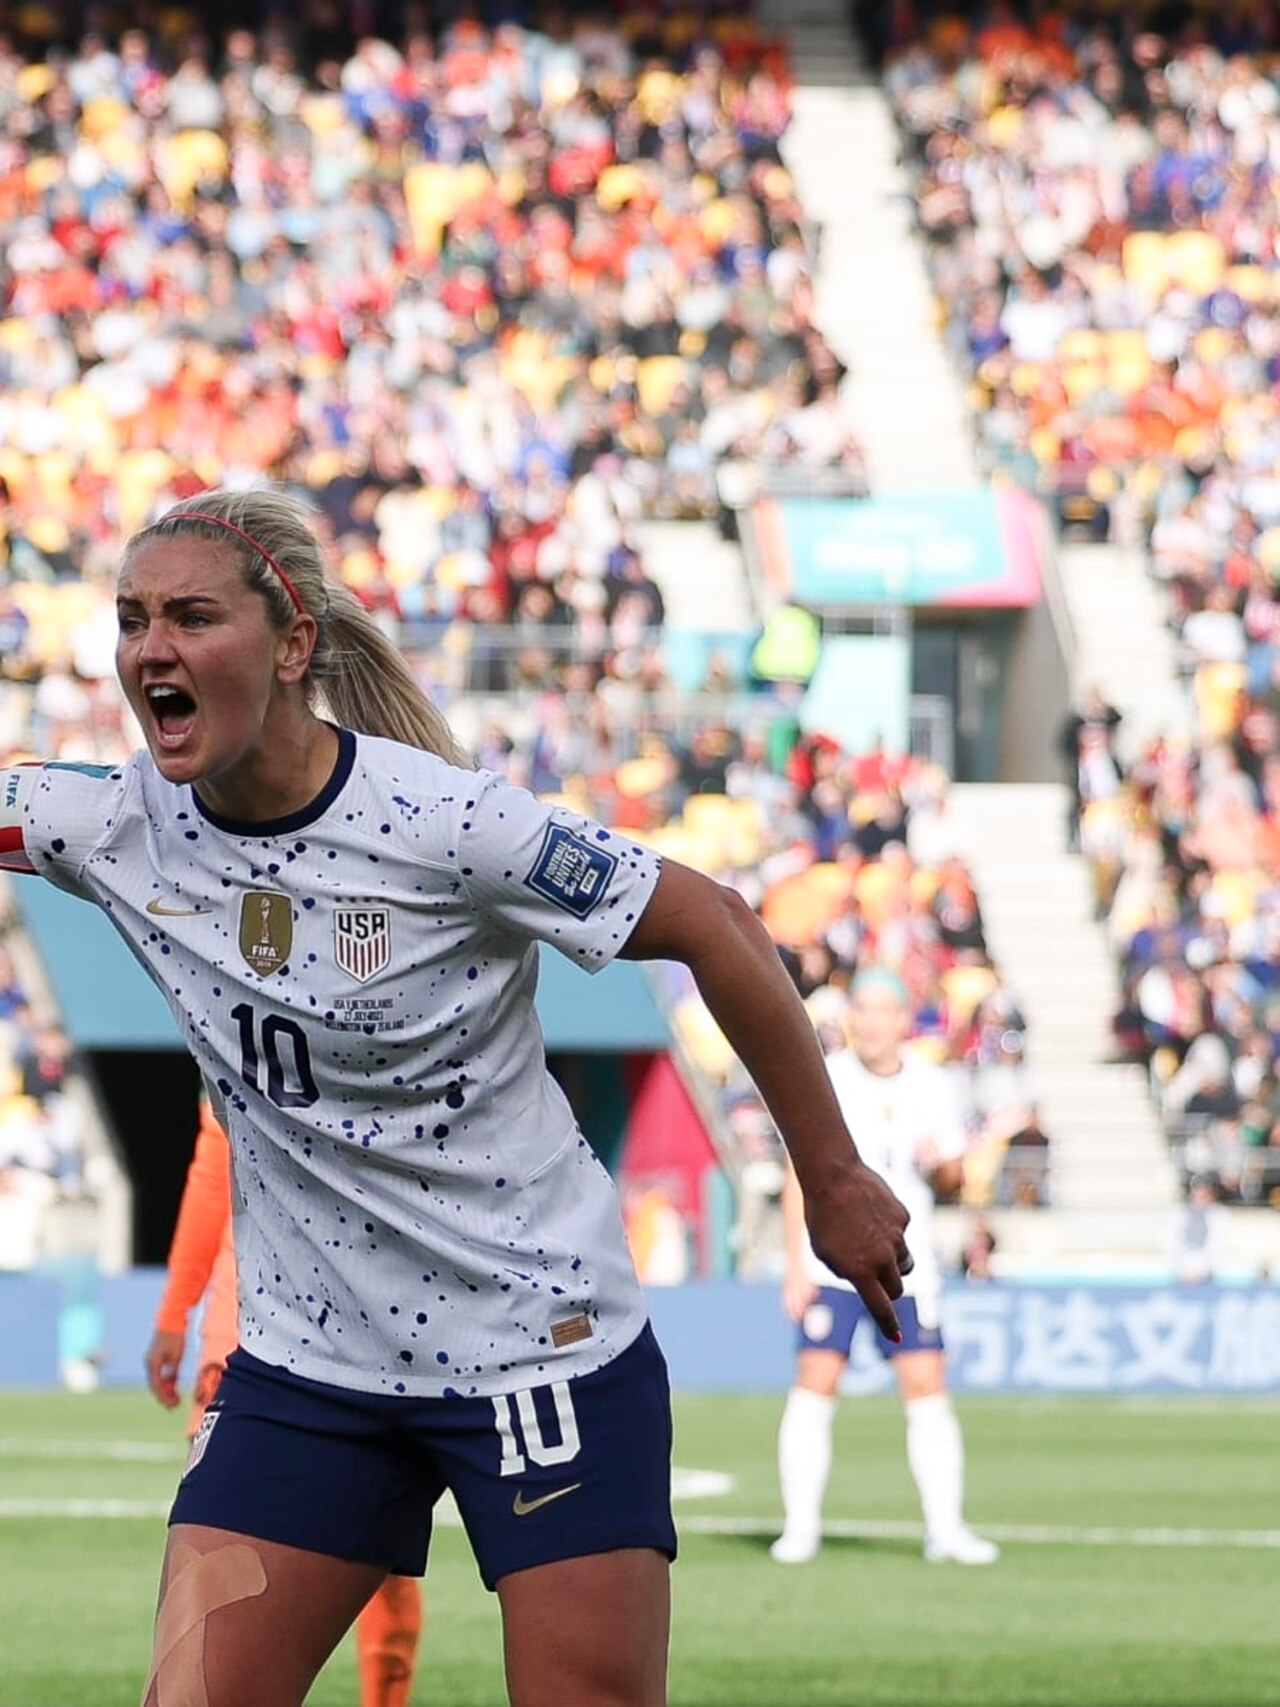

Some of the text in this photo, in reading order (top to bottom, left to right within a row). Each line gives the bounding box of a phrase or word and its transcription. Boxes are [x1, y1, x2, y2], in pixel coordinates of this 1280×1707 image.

[6, 774, 20, 807] FIFA
[543, 840, 568, 880] FOOTBALL
[551, 845, 580, 887] UNITES
[338, 912, 385, 940] USA
[252, 944, 277, 957] FIFA
[231, 1002, 320, 1108] 10
[491, 1381, 581, 1477] 10
